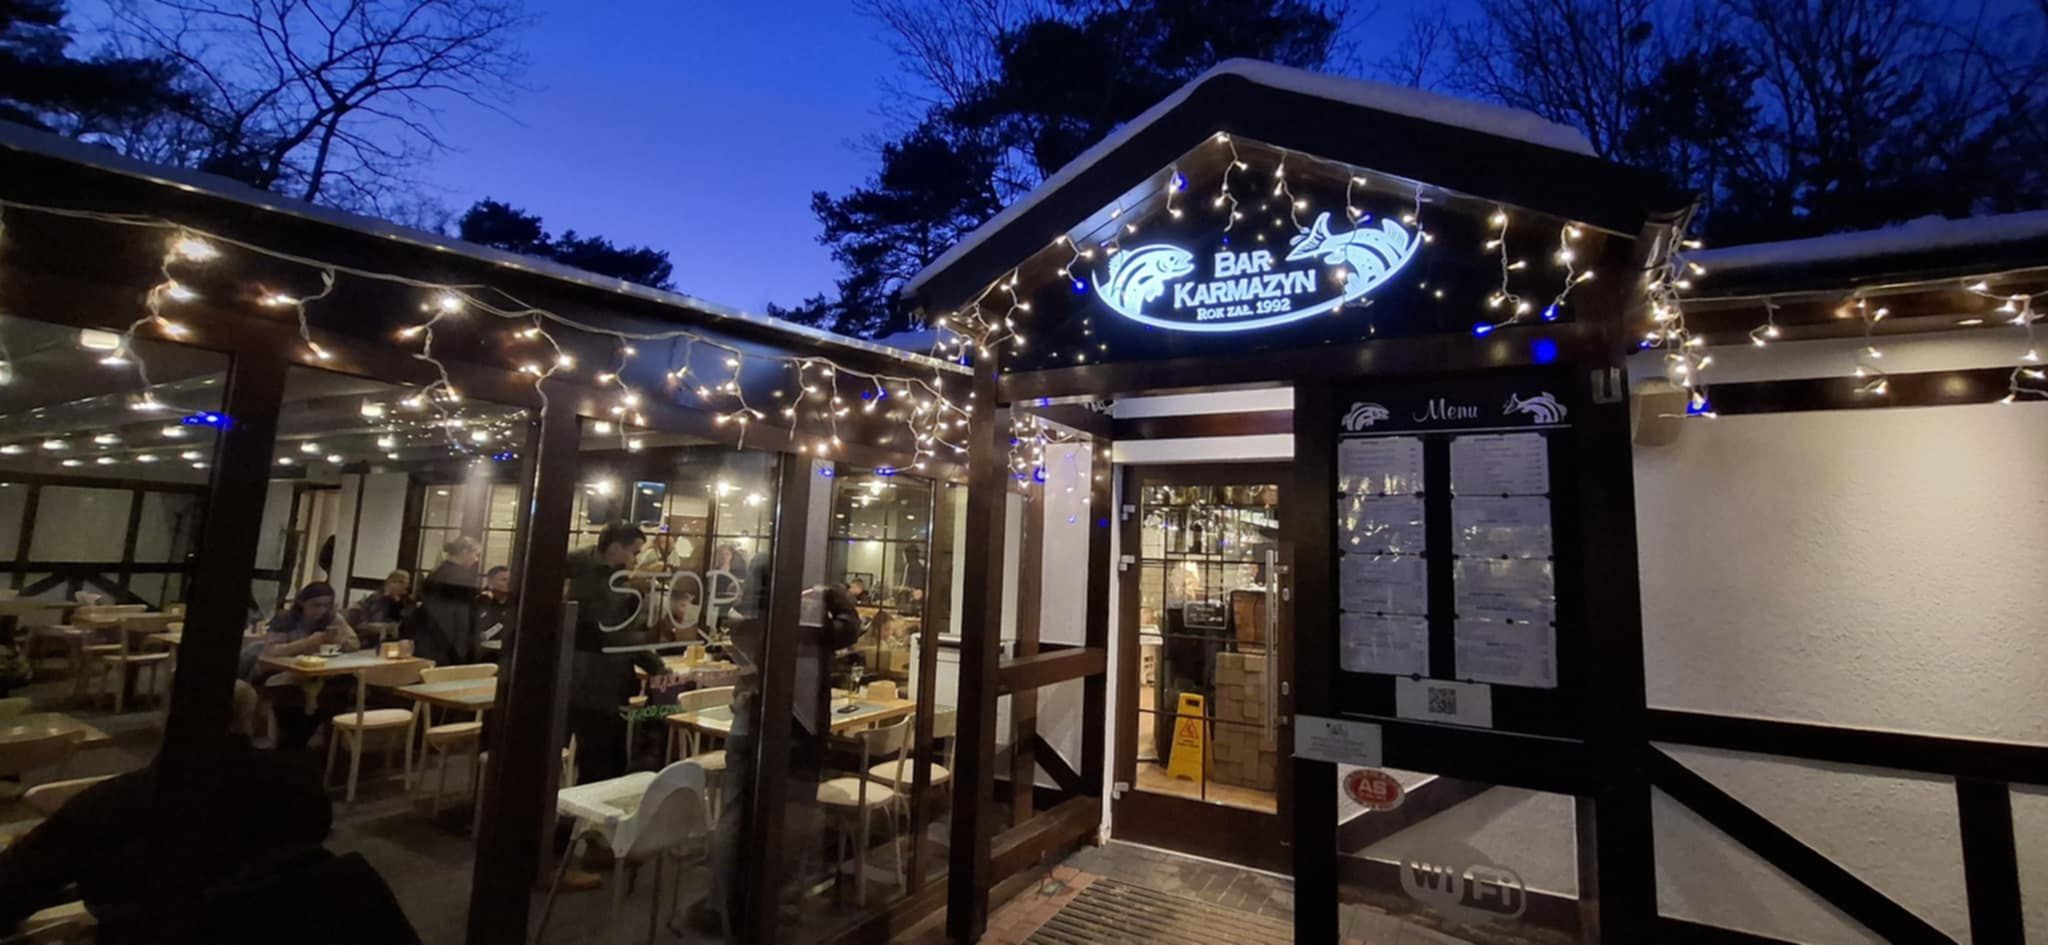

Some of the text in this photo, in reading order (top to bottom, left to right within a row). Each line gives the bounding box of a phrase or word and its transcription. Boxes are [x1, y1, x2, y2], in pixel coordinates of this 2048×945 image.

[1214, 251, 1271, 278] BAR
[1174, 269, 1316, 309] KARMAZYN
[1256, 299, 1290, 313] 1992
[1412, 398, 1478, 422] Menu
[599, 570, 741, 633] STOP
